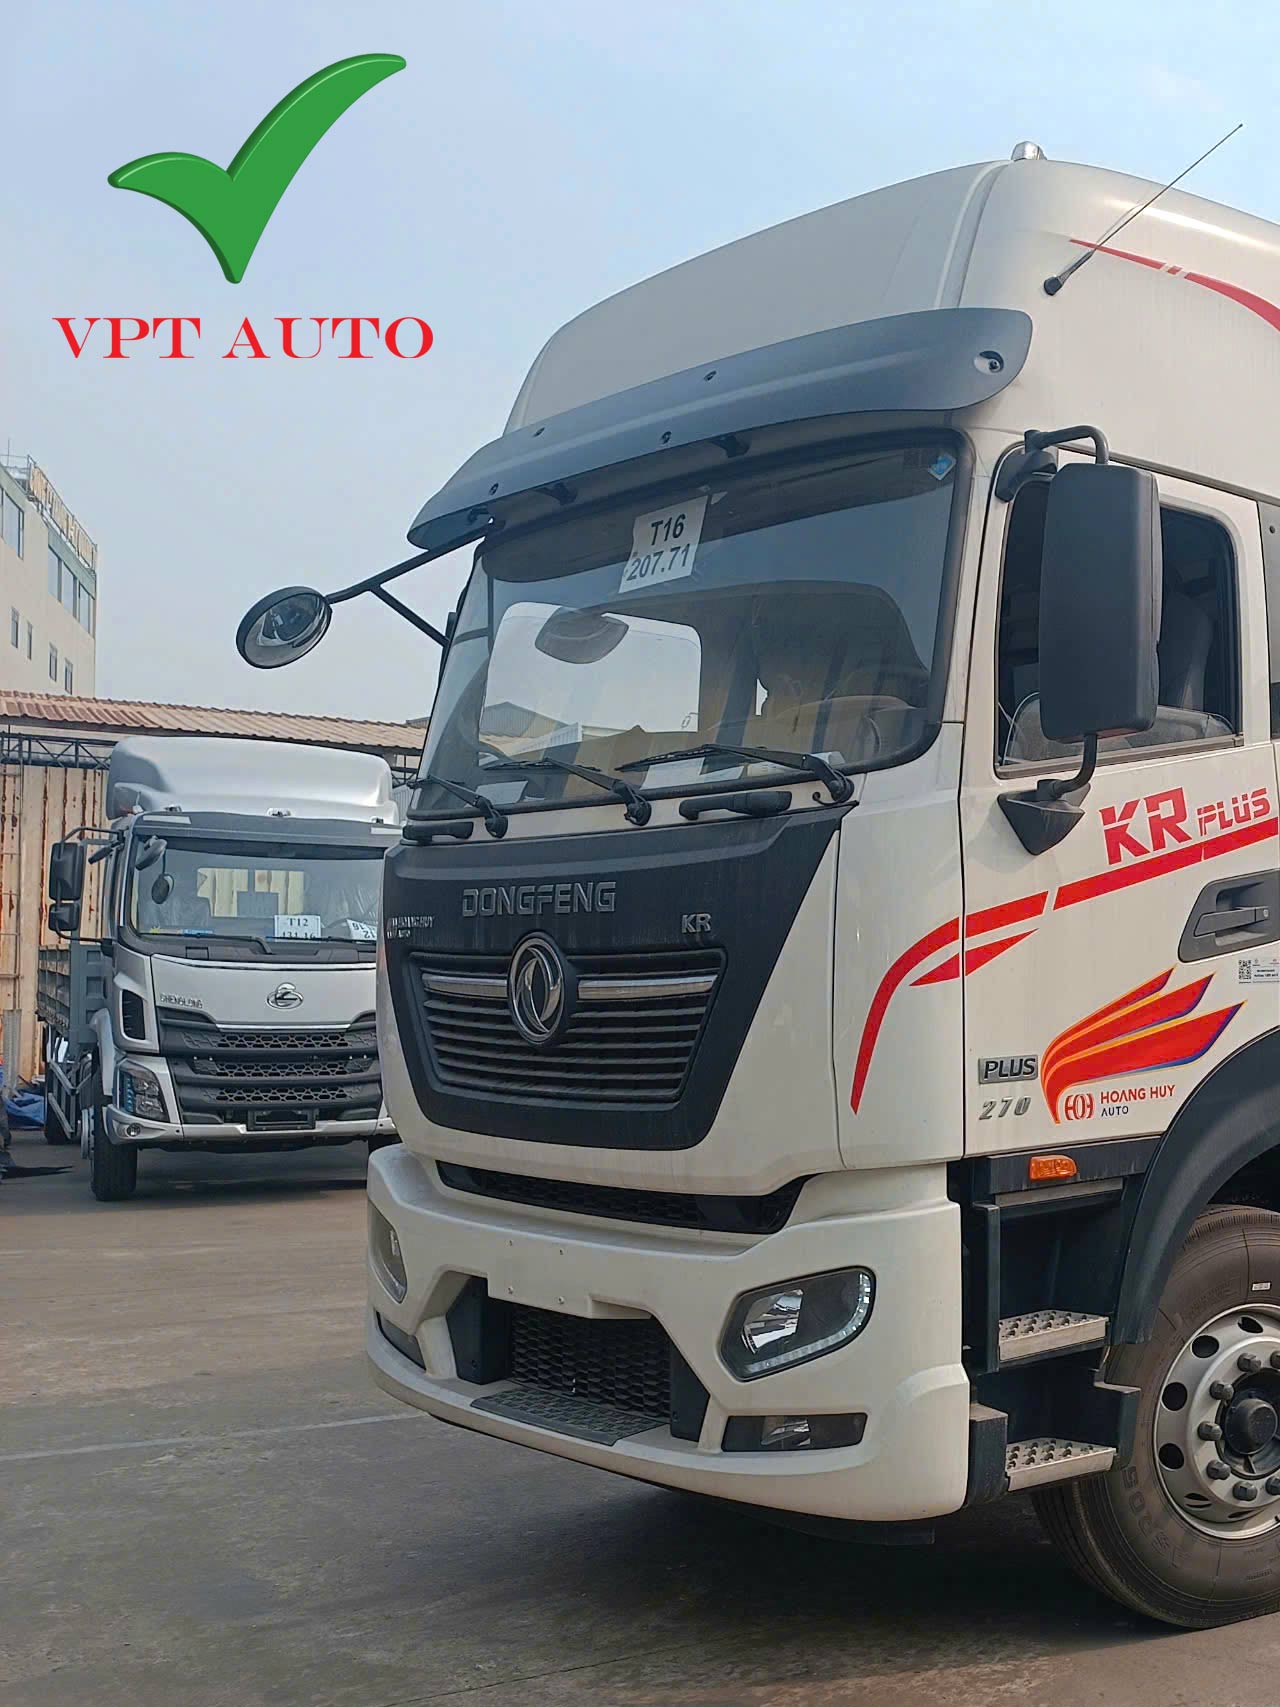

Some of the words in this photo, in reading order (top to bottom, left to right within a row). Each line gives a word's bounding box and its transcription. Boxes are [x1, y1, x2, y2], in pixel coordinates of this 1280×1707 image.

[650, 513, 686, 546] T16
[625, 543, 690, 581] 207.71
[1099, 787, 1193, 866] KR
[1197, 787, 1271, 837] PLUS
[462, 881, 617, 918] DONGFENG
[287, 917, 309, 927] T12
[681, 912, 712, 934] KR
[984, 1057, 1036, 1079] PLUS
[1100, 1087, 1146, 1105] HOANG
[1150, 1084, 1175, 1100] HUY
[978, 1096, 1032, 1121] 270
[1101, 1105, 1129, 1117] AUTO
